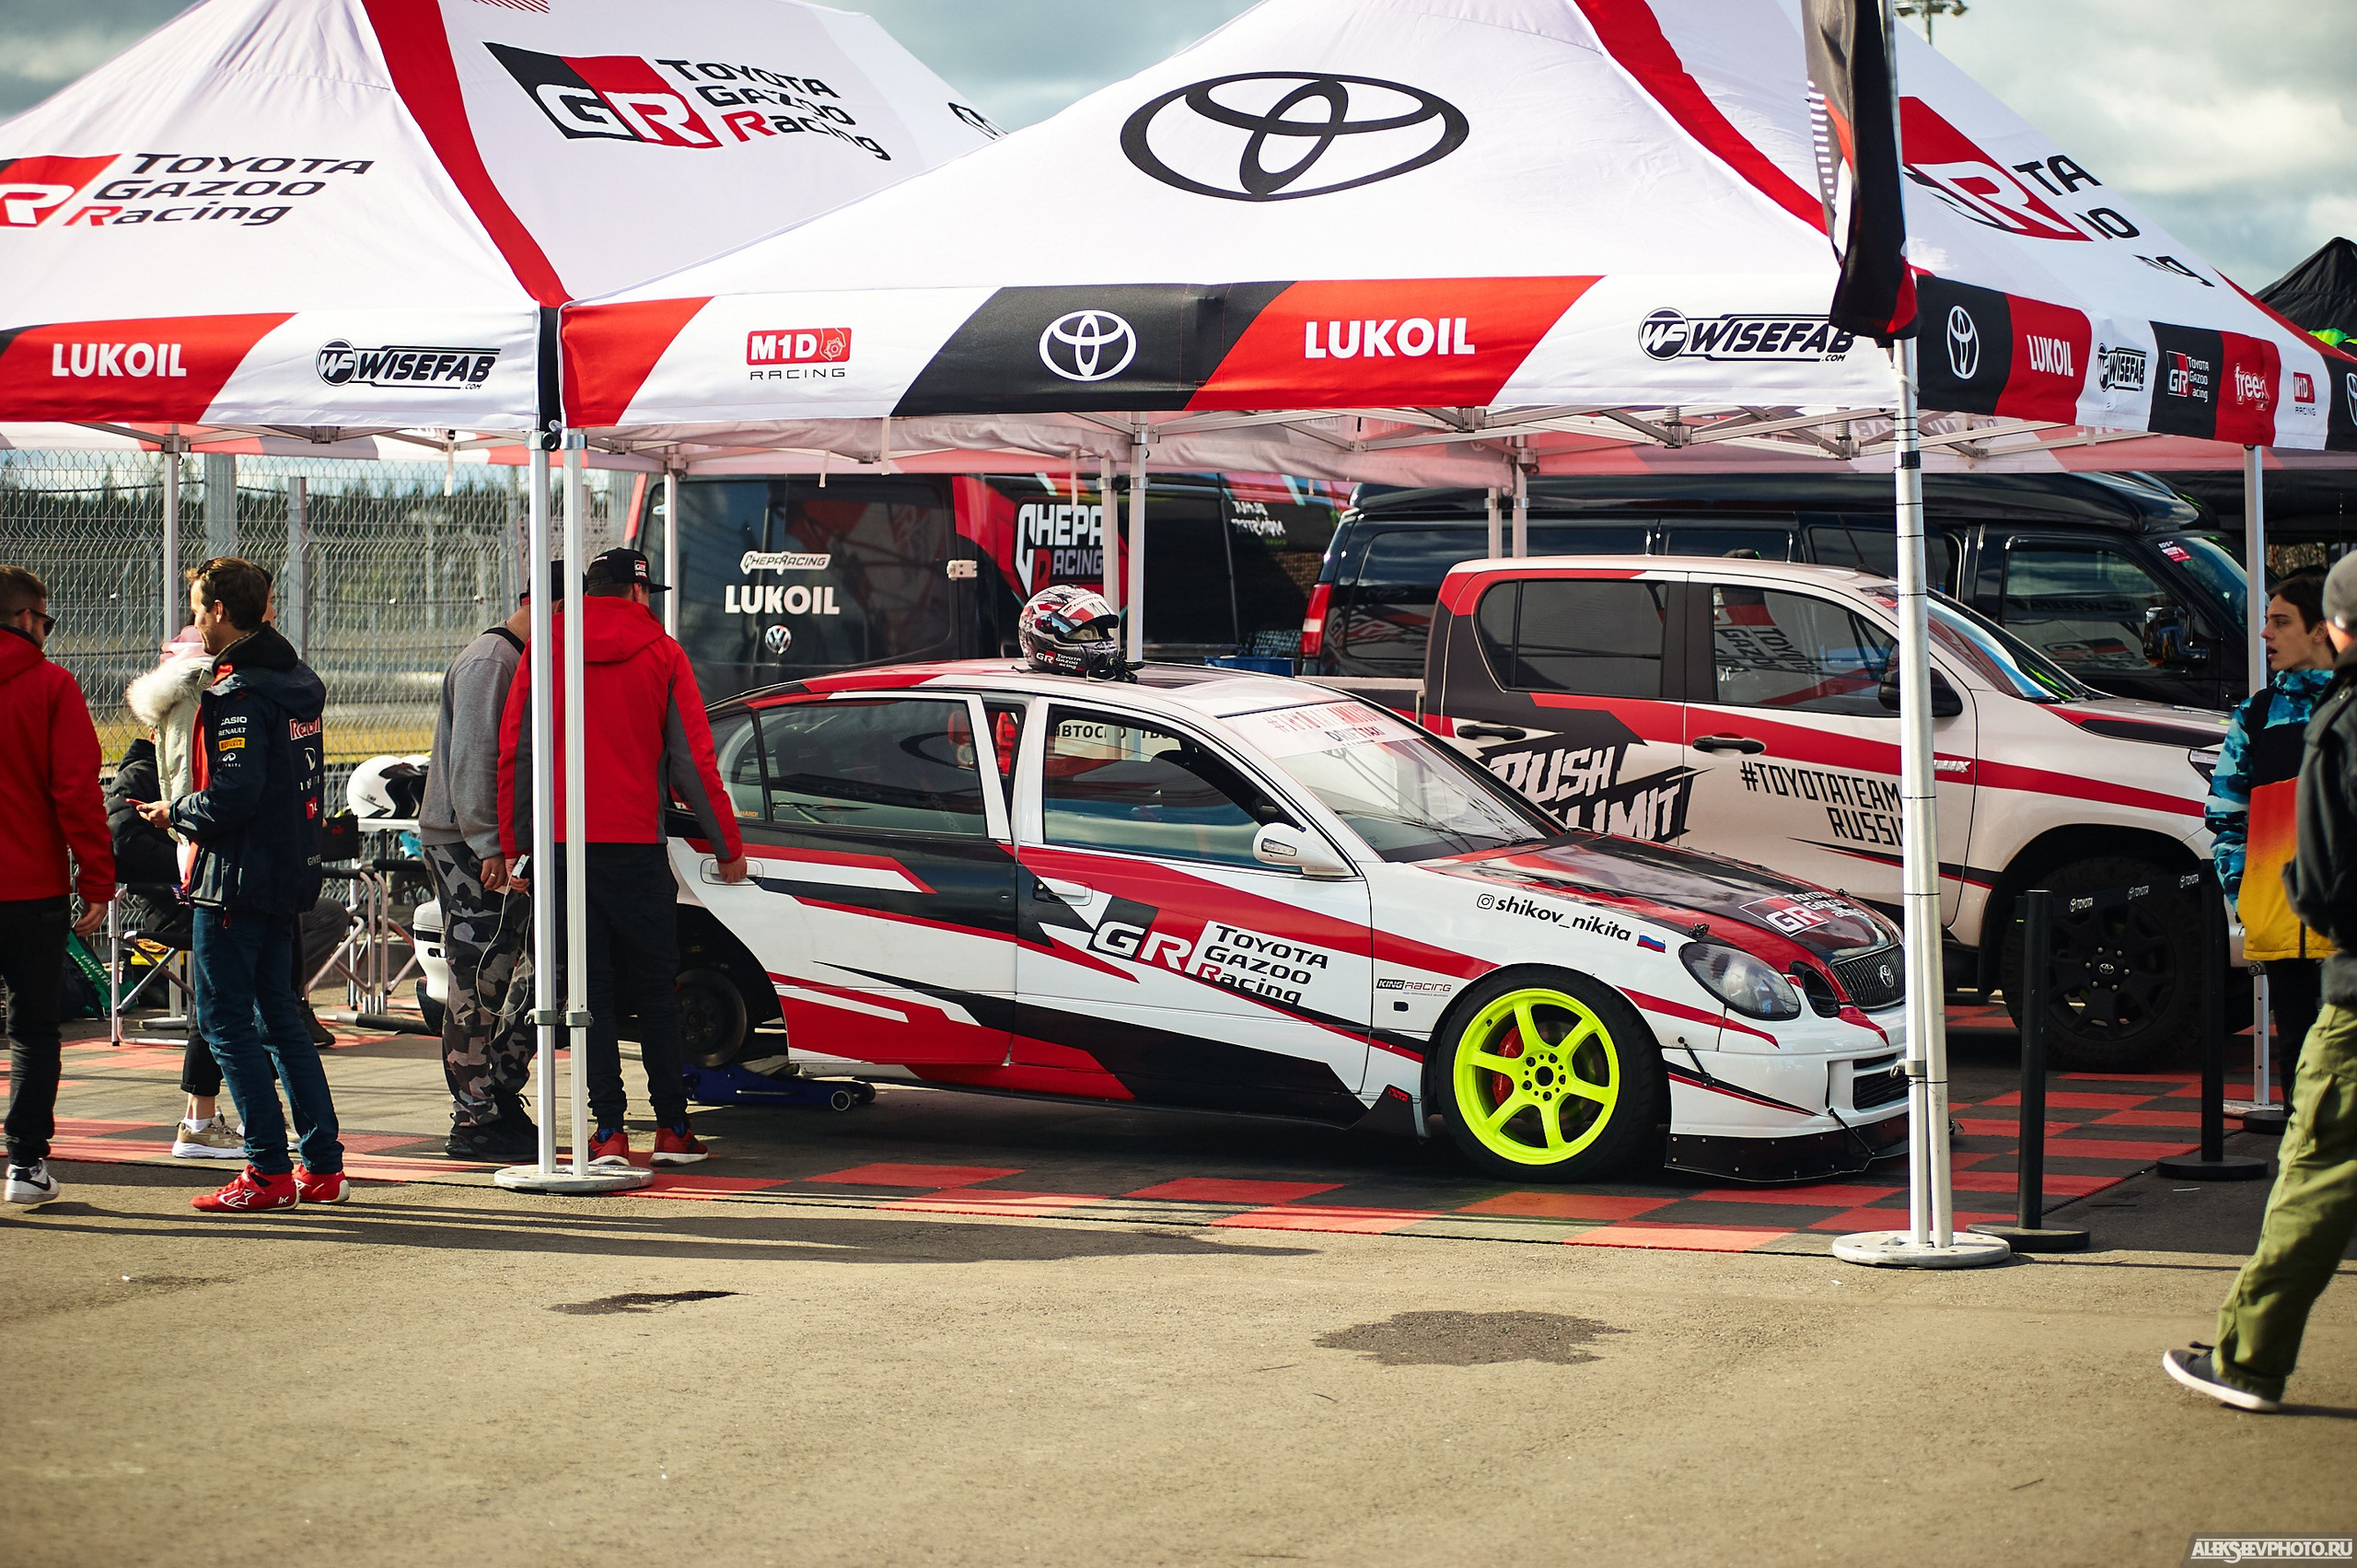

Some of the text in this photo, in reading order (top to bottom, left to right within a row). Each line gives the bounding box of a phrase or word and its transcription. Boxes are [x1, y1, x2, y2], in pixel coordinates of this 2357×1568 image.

[655, 59, 840, 99] TOYOTA
[536, 84, 708, 146] GR
[695, 85, 856, 127] GAZOO
[723, 111, 892, 162] Racing
[123, 154, 375, 176] TOYOTA
[94, 180, 326, 201] GAZOO
[64, 206, 293, 226] Racing
[751, 336, 817, 361] M1D
[1305, 317, 1476, 360] LUKOIL
[1690, 321, 1854, 354] WISEFAB
[52, 343, 187, 377] LUKOIL
[358, 351, 496, 382] WISEFAB
[2026, 333, 2074, 378] LUKOIL
[2187, 356, 2209, 372] TOYOTA
[750, 368, 846, 379] RACING
[2189, 370, 2209, 386] GAZOO
[725, 585, 841, 615] LUKOIL
[218, 727, 247, 737] RENAULT
[1495, 896, 1632, 942] shikov_nikita
[1093, 921, 1192, 971] GR
[1215, 924, 1329, 970] TOYOTA
[1203, 945, 1312, 985] GAZOO
[1197, 962, 1303, 1006] Racing
[1377, 980, 1404, 989] KING
